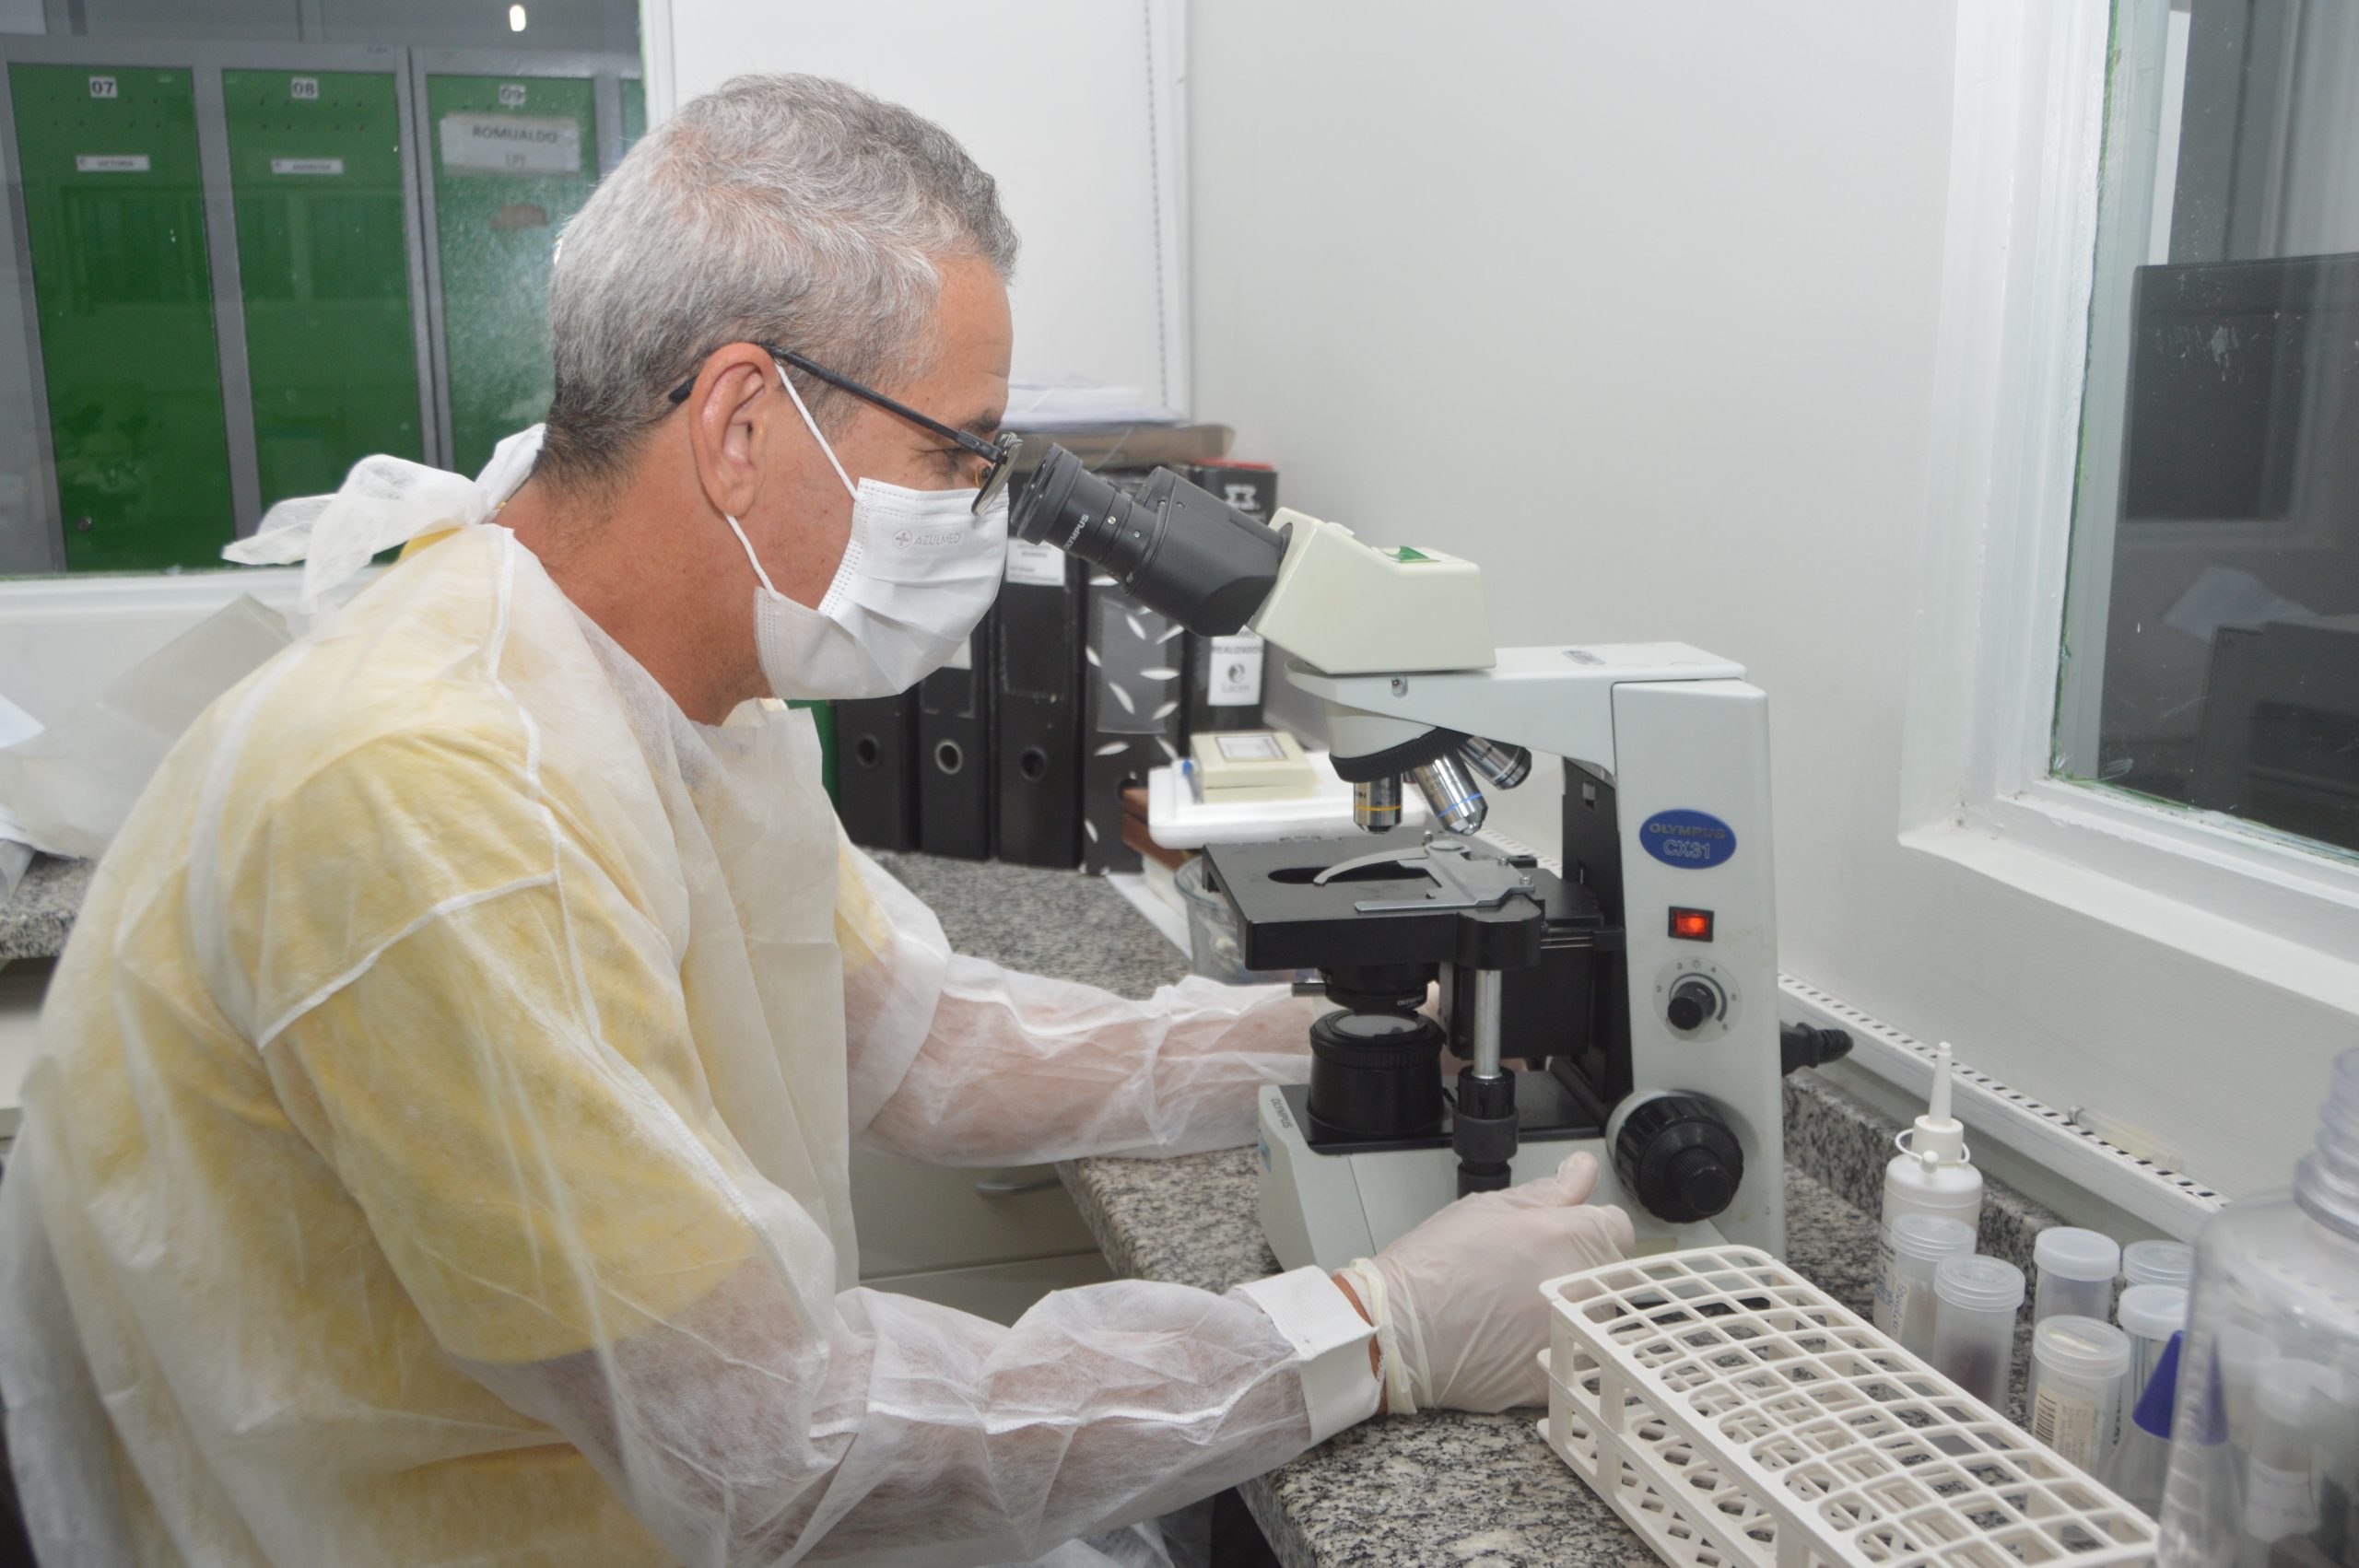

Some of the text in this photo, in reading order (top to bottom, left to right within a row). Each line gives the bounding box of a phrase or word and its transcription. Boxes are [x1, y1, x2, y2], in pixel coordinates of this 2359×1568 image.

[92, 80, 113, 95] 07
[293, 82, 315, 96] 08
[472, 125, 558, 145] ROMUALDO
[913, 532, 960, 546] AZULMED
[1062, 513, 1089, 550] OLYMPUS
[1649, 823, 1726, 840] OLYMPUS
[1662, 839, 1710, 860] CX31
